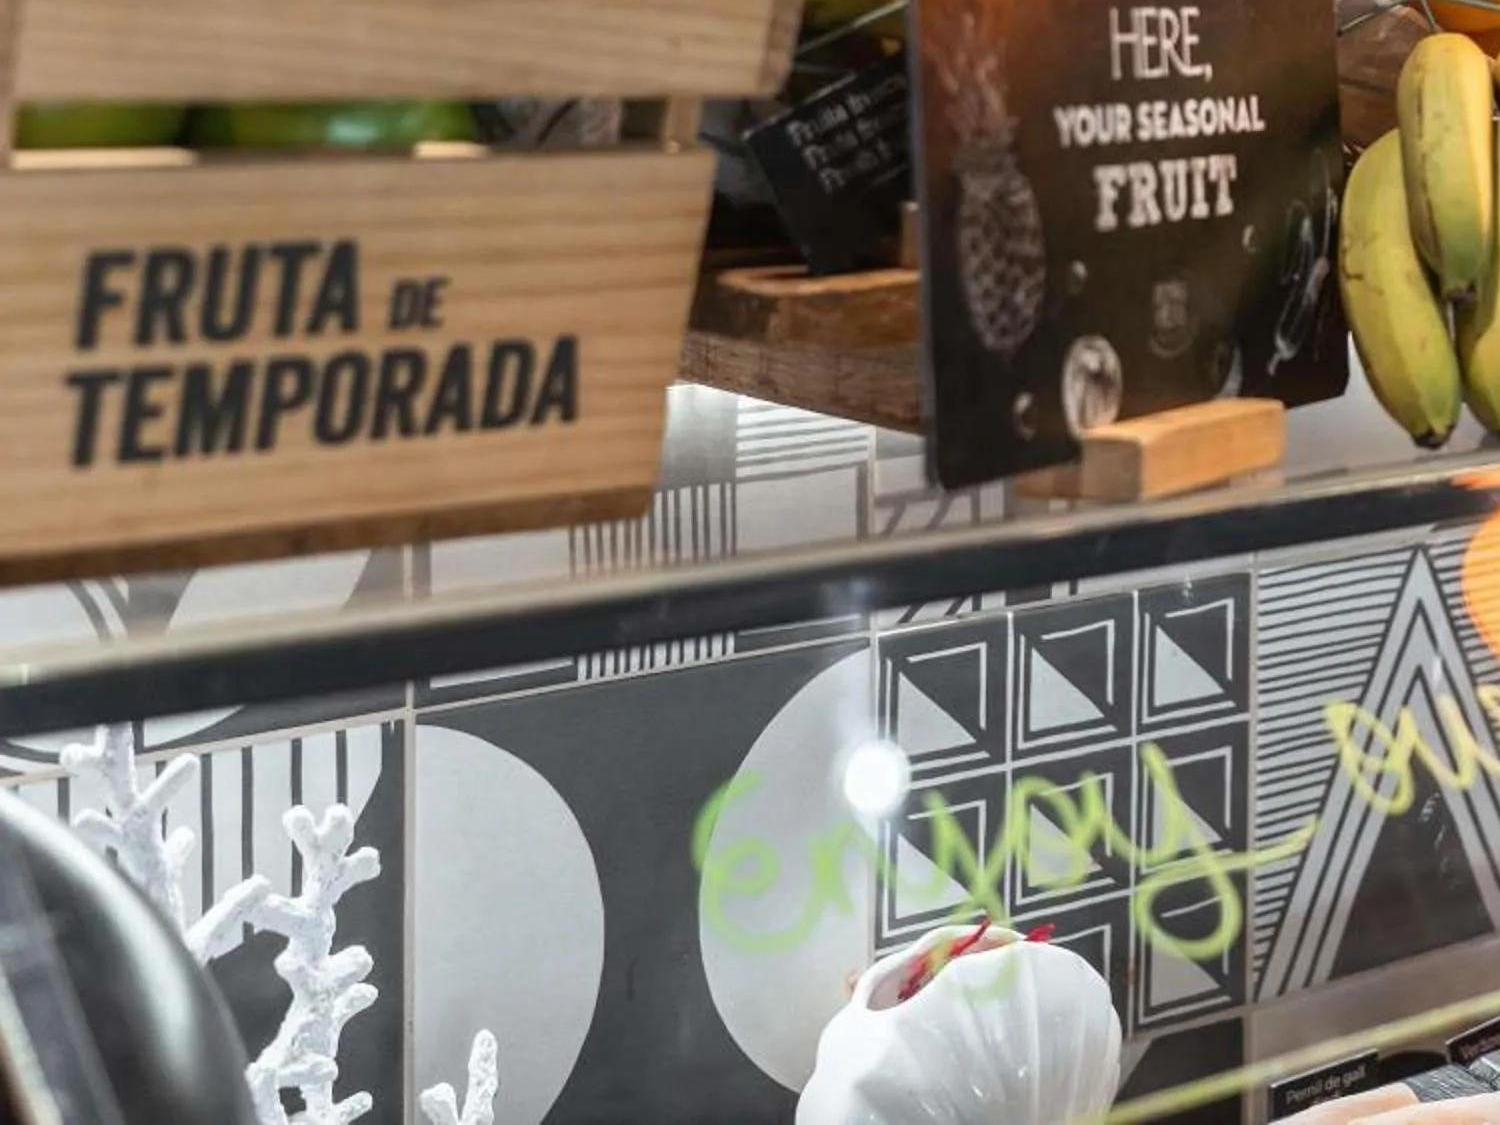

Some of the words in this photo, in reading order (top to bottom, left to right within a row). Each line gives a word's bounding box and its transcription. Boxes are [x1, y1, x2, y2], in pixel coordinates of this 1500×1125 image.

[1109, 6, 1213, 81] HERE,
[1053, 102, 1133, 148] YOUR
[1136, 94, 1266, 142] SEASONAL
[1093, 154, 1238, 232] FRUIT
[75, 238, 362, 352] FRUTA
[388, 277, 450, 331] DE
[66, 335, 580, 469] TEMPORADA
[692, 743, 1316, 1000] Enjoy
